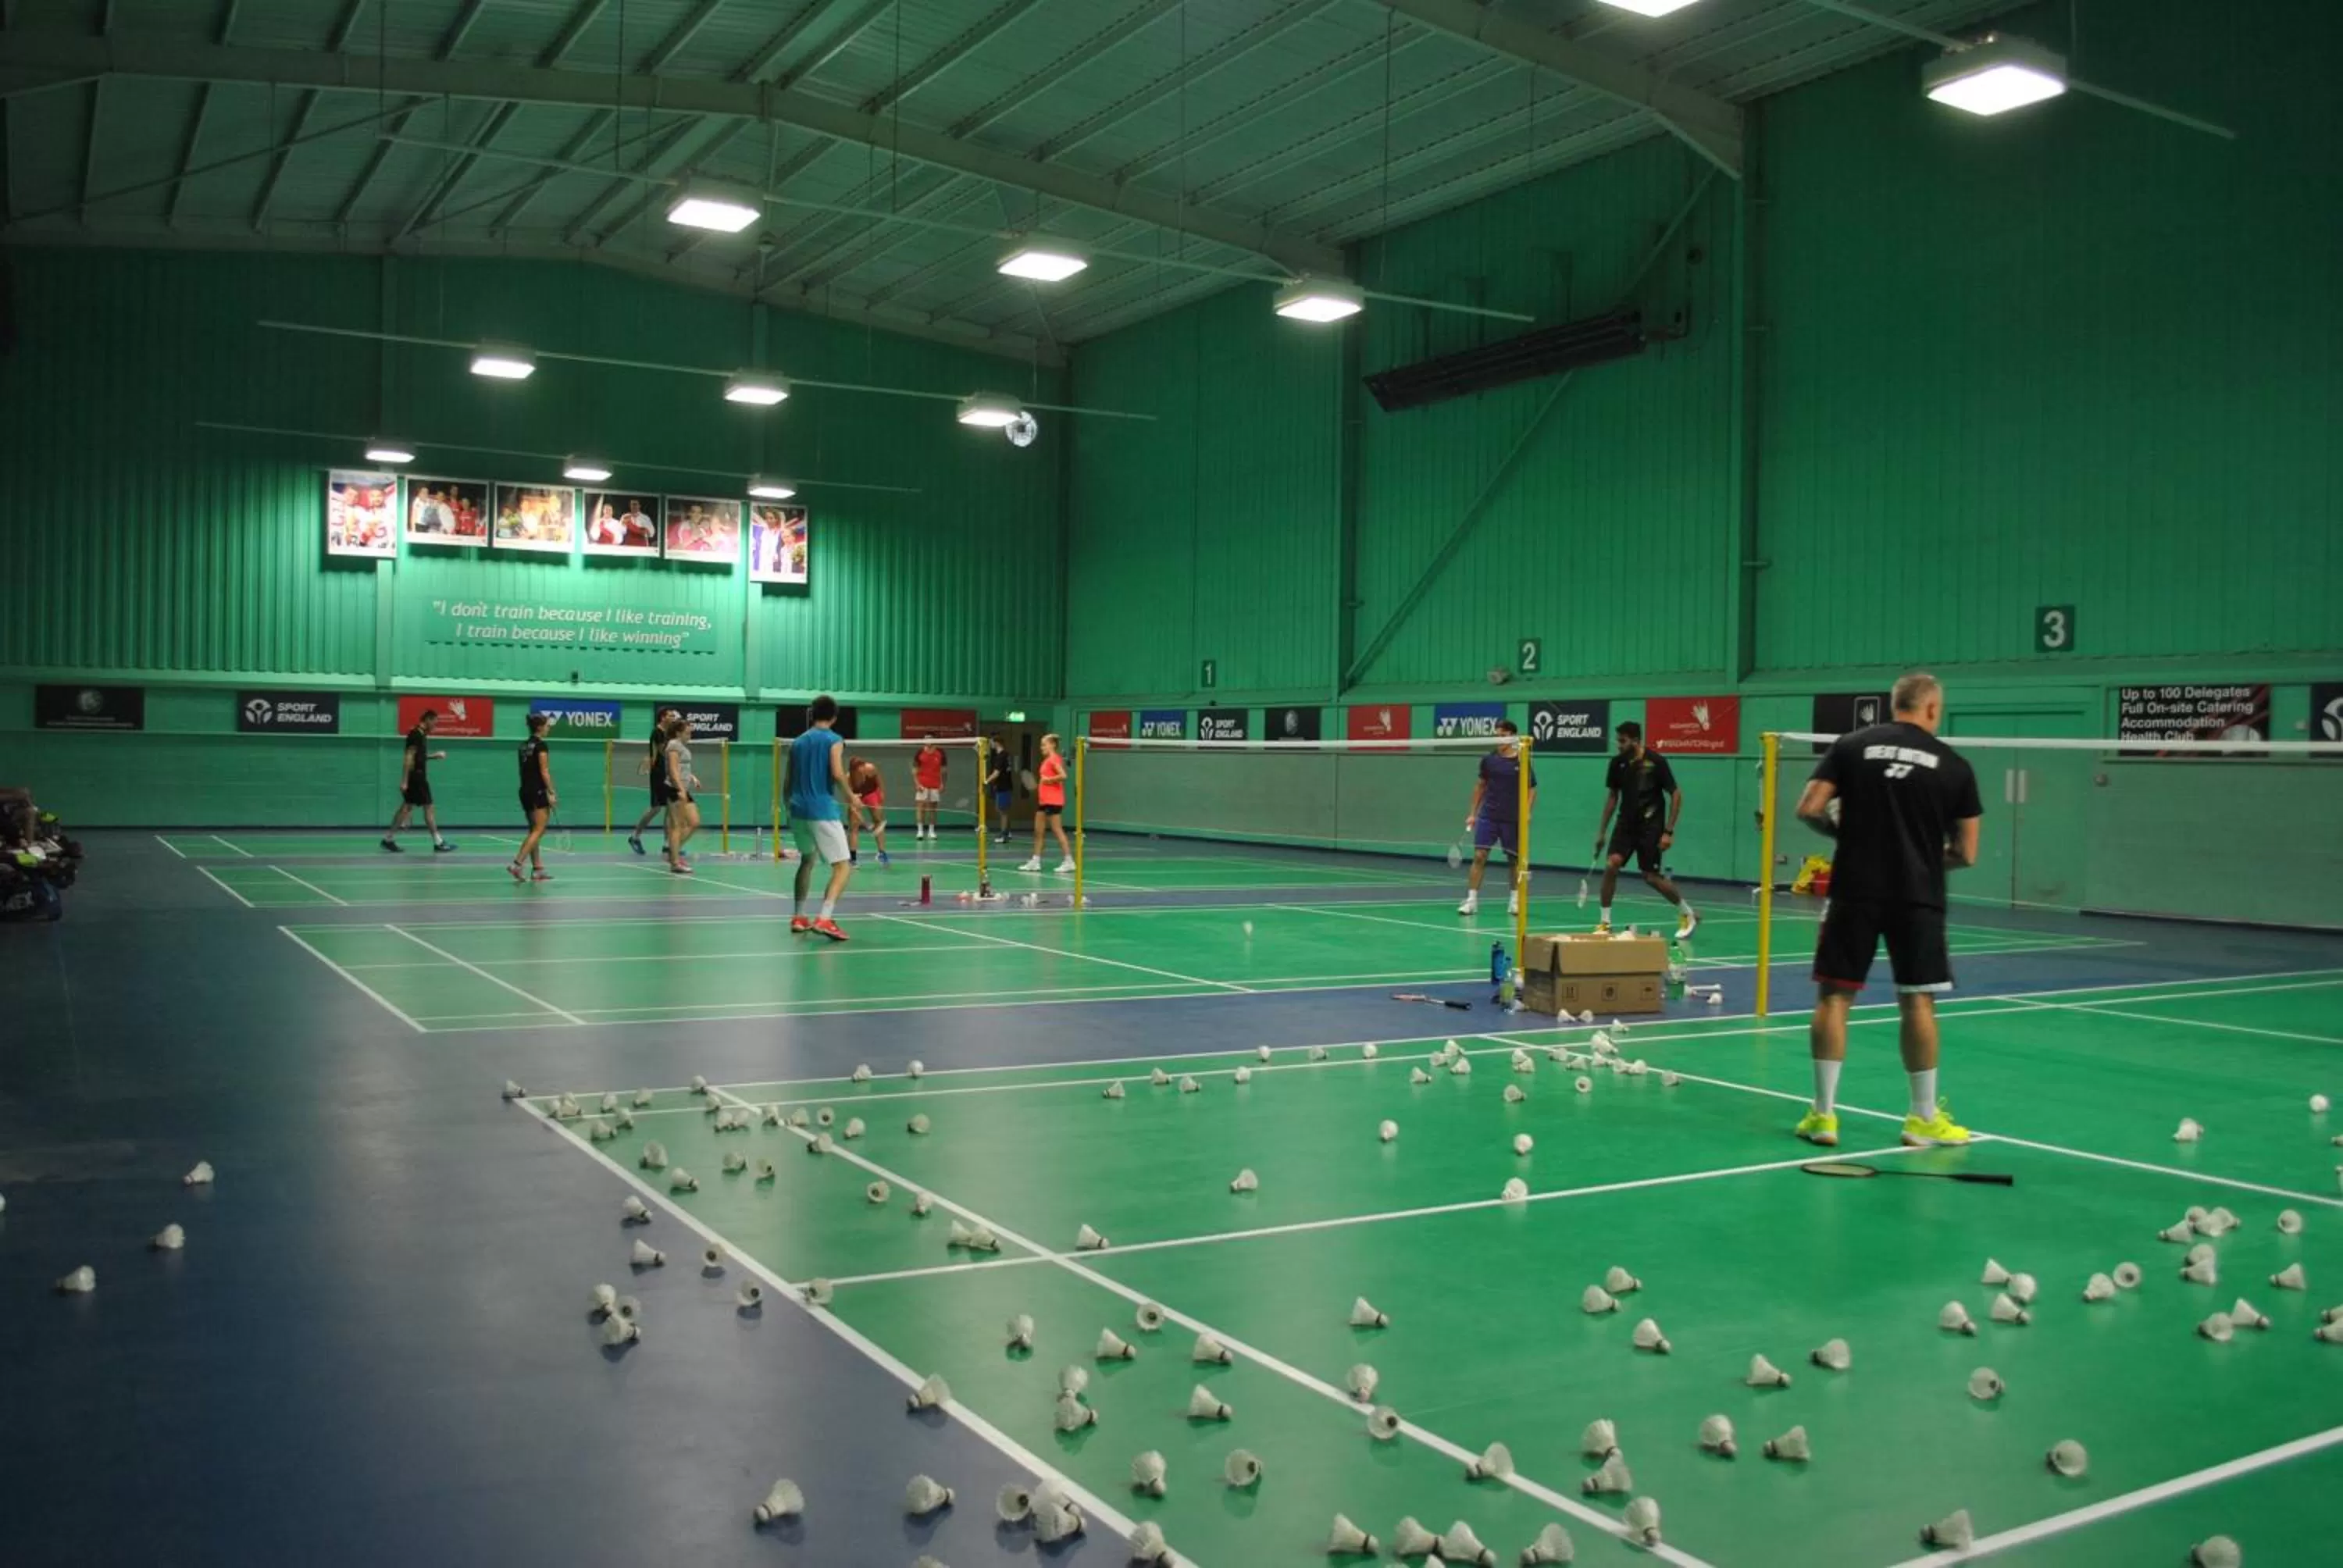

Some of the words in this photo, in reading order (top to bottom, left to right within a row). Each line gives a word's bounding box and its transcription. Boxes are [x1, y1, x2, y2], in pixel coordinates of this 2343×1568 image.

[451, 600, 488, 618] don't
[494, 604, 534, 620] train
[538, 605, 603, 623] because
[605, 608, 612, 622] I
[615, 608, 644, 624] like
[648, 611, 711, 630] training,
[455, 622, 463, 637] I
[467, 624, 507, 639] train
[512, 625, 576, 641] because
[578, 627, 585, 642] I
[589, 628, 619, 643] like
[2042, 609, 2066, 648] 3
[1522, 641, 1536, 670] 2
[2122, 688, 2140, 700] Up
[2143, 689, 2156, 699] to
[2159, 687, 2181, 699] 100
[2184, 686, 2251, 700] Delegates
[277, 702, 317, 712] SPORT
[2122, 702, 2143, 715] Full
[2147, 702, 2194, 714] On-site
[2197, 701, 2254, 715] Catering
[277, 713, 332, 723] ENGLAND
[565, 711, 613, 727] YONEX
[686, 712, 719, 722] SPORT
[1557, 714, 1589, 725] SPORT
[2121, 716, 2226, 729] Accommodation
[1156, 722, 1181, 736] YONEX
[1215, 719, 1236, 729] SPORT
[1460, 718, 1499, 736] YONEX
[1215, 729, 1243, 738] ENGLAND
[1557, 727, 1602, 739] ENGLAND
[2121, 731, 2162, 743] Health
[2165, 731, 2195, 743] Club
